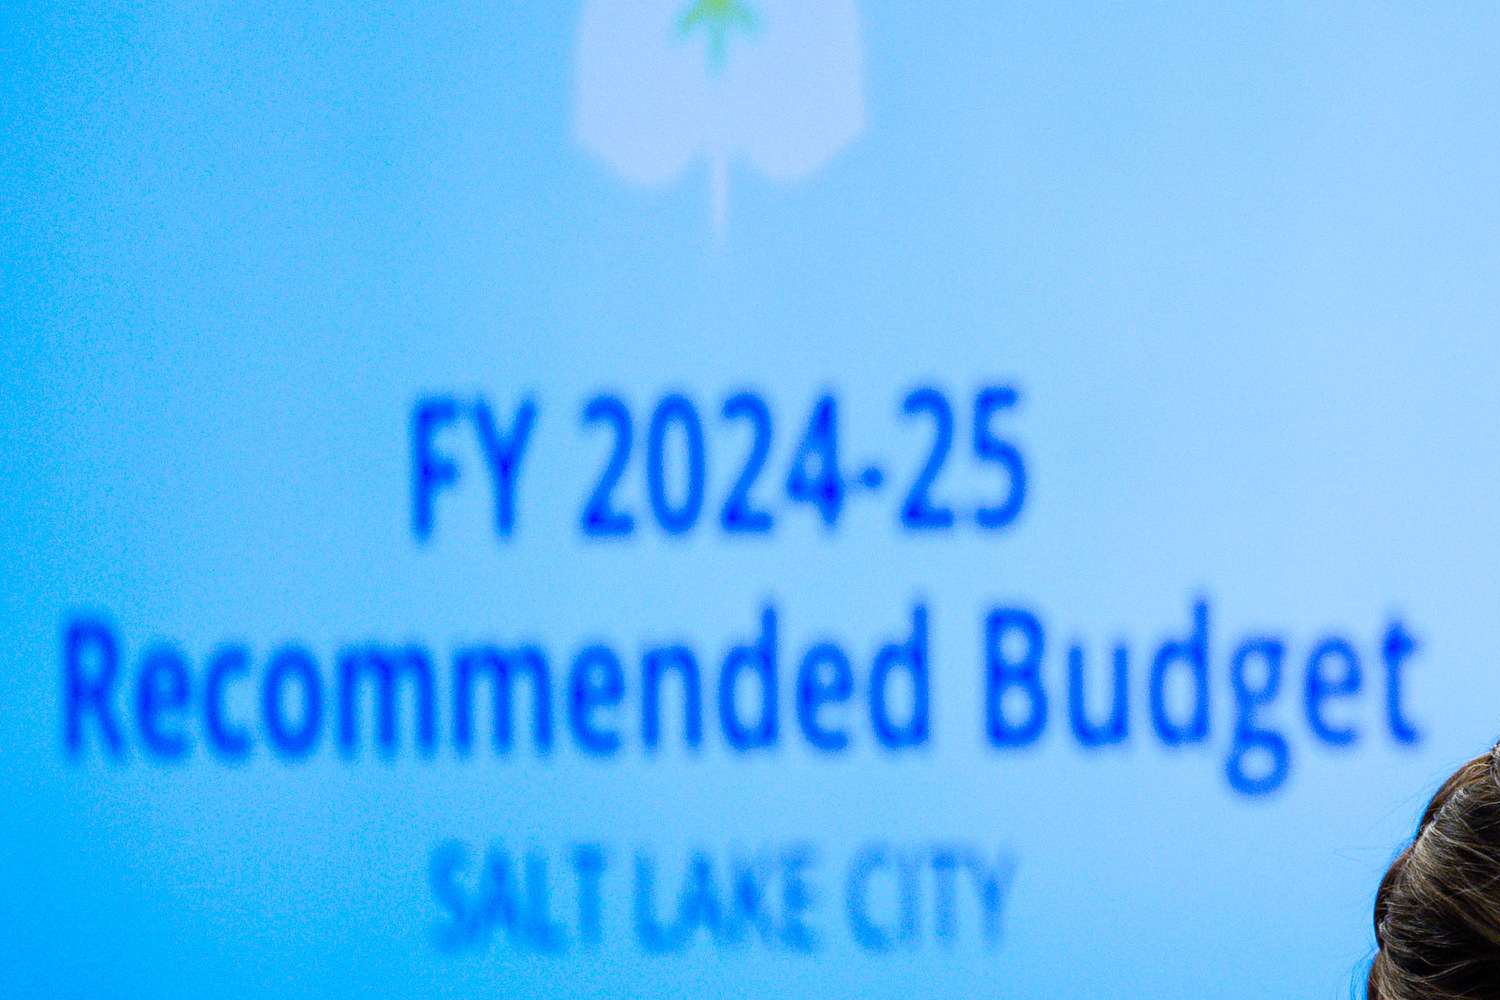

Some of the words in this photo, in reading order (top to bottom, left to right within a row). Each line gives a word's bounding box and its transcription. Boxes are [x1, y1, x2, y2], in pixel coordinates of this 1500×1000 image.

[411, 396, 537, 540] FY
[577, 385, 1030, 538] 2024-25
[60, 602, 931, 760] Recommended
[983, 600, 1424, 796] Budget
[428, 840, 608, 954] SALT
[632, 842, 820, 952] LAKE
[846, 846, 1016, 952] CITY
